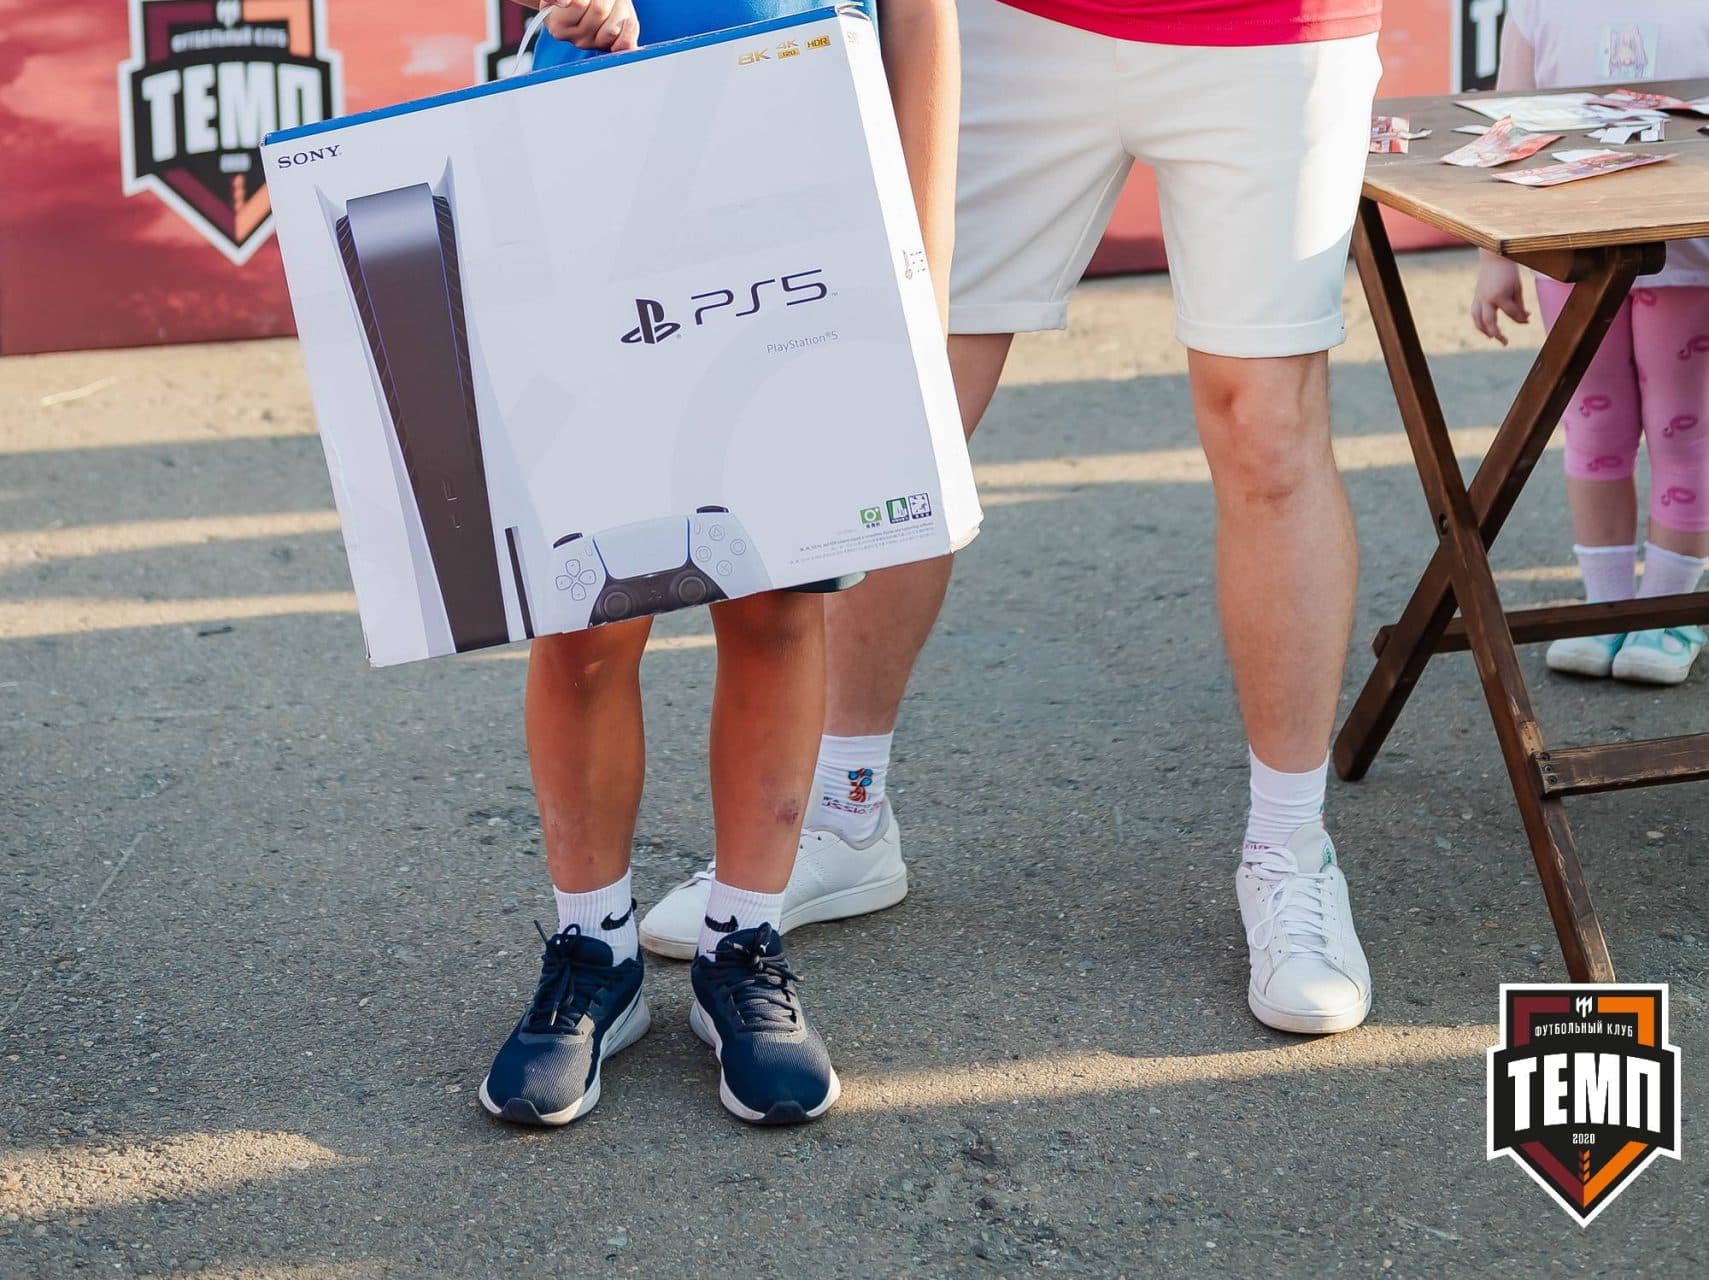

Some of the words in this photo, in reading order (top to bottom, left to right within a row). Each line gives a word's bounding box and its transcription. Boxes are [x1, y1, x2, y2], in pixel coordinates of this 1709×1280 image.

[806, 35, 831, 49] HDR
[141, 61, 323, 161] ТЕМП
[278, 145, 340, 169] SONY
[691, 269, 828, 326] PS5
